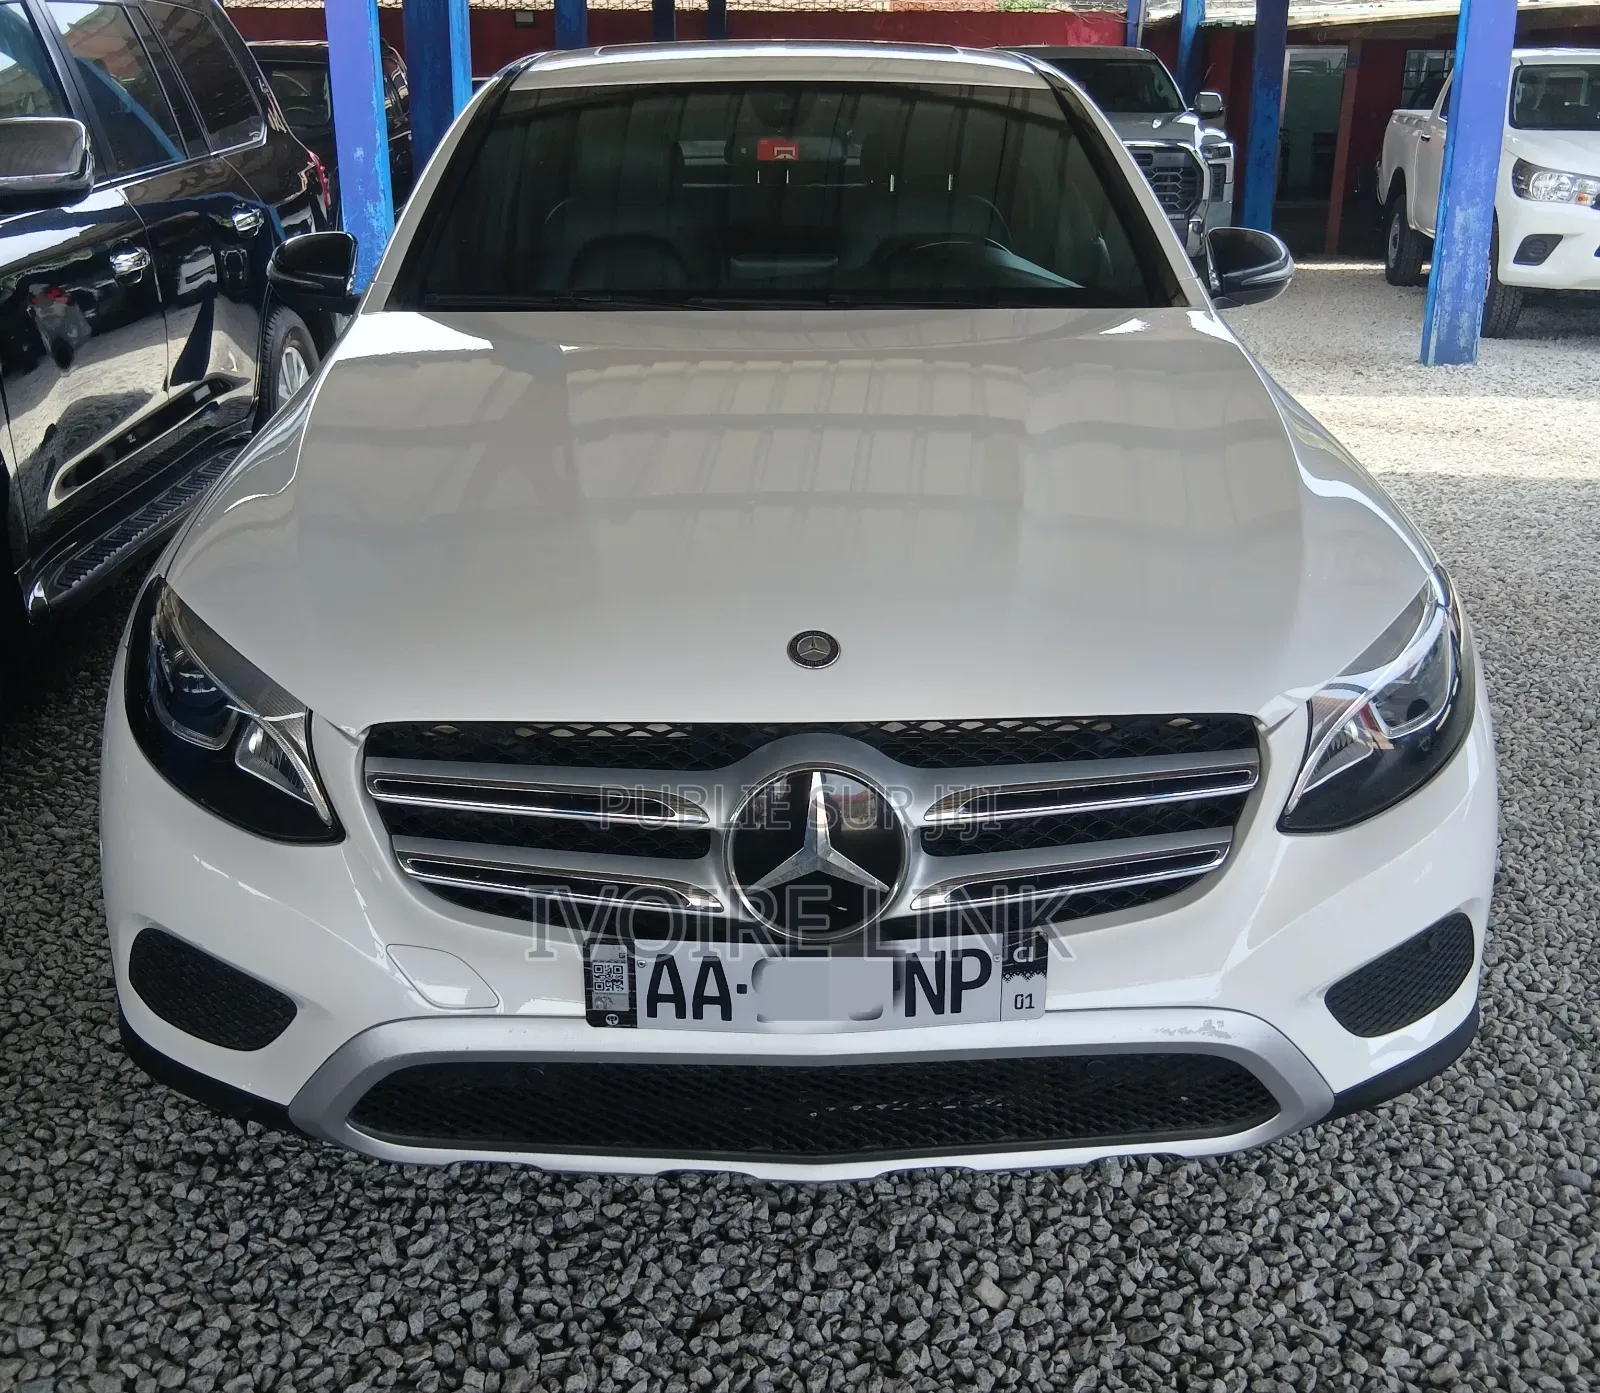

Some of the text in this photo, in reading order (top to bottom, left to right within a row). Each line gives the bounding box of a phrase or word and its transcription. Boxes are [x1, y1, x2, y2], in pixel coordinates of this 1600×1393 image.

[1012, 946, 1034, 963] CI
[904, 948, 992, 1017] NP
[1014, 993, 1035, 1010] 01
